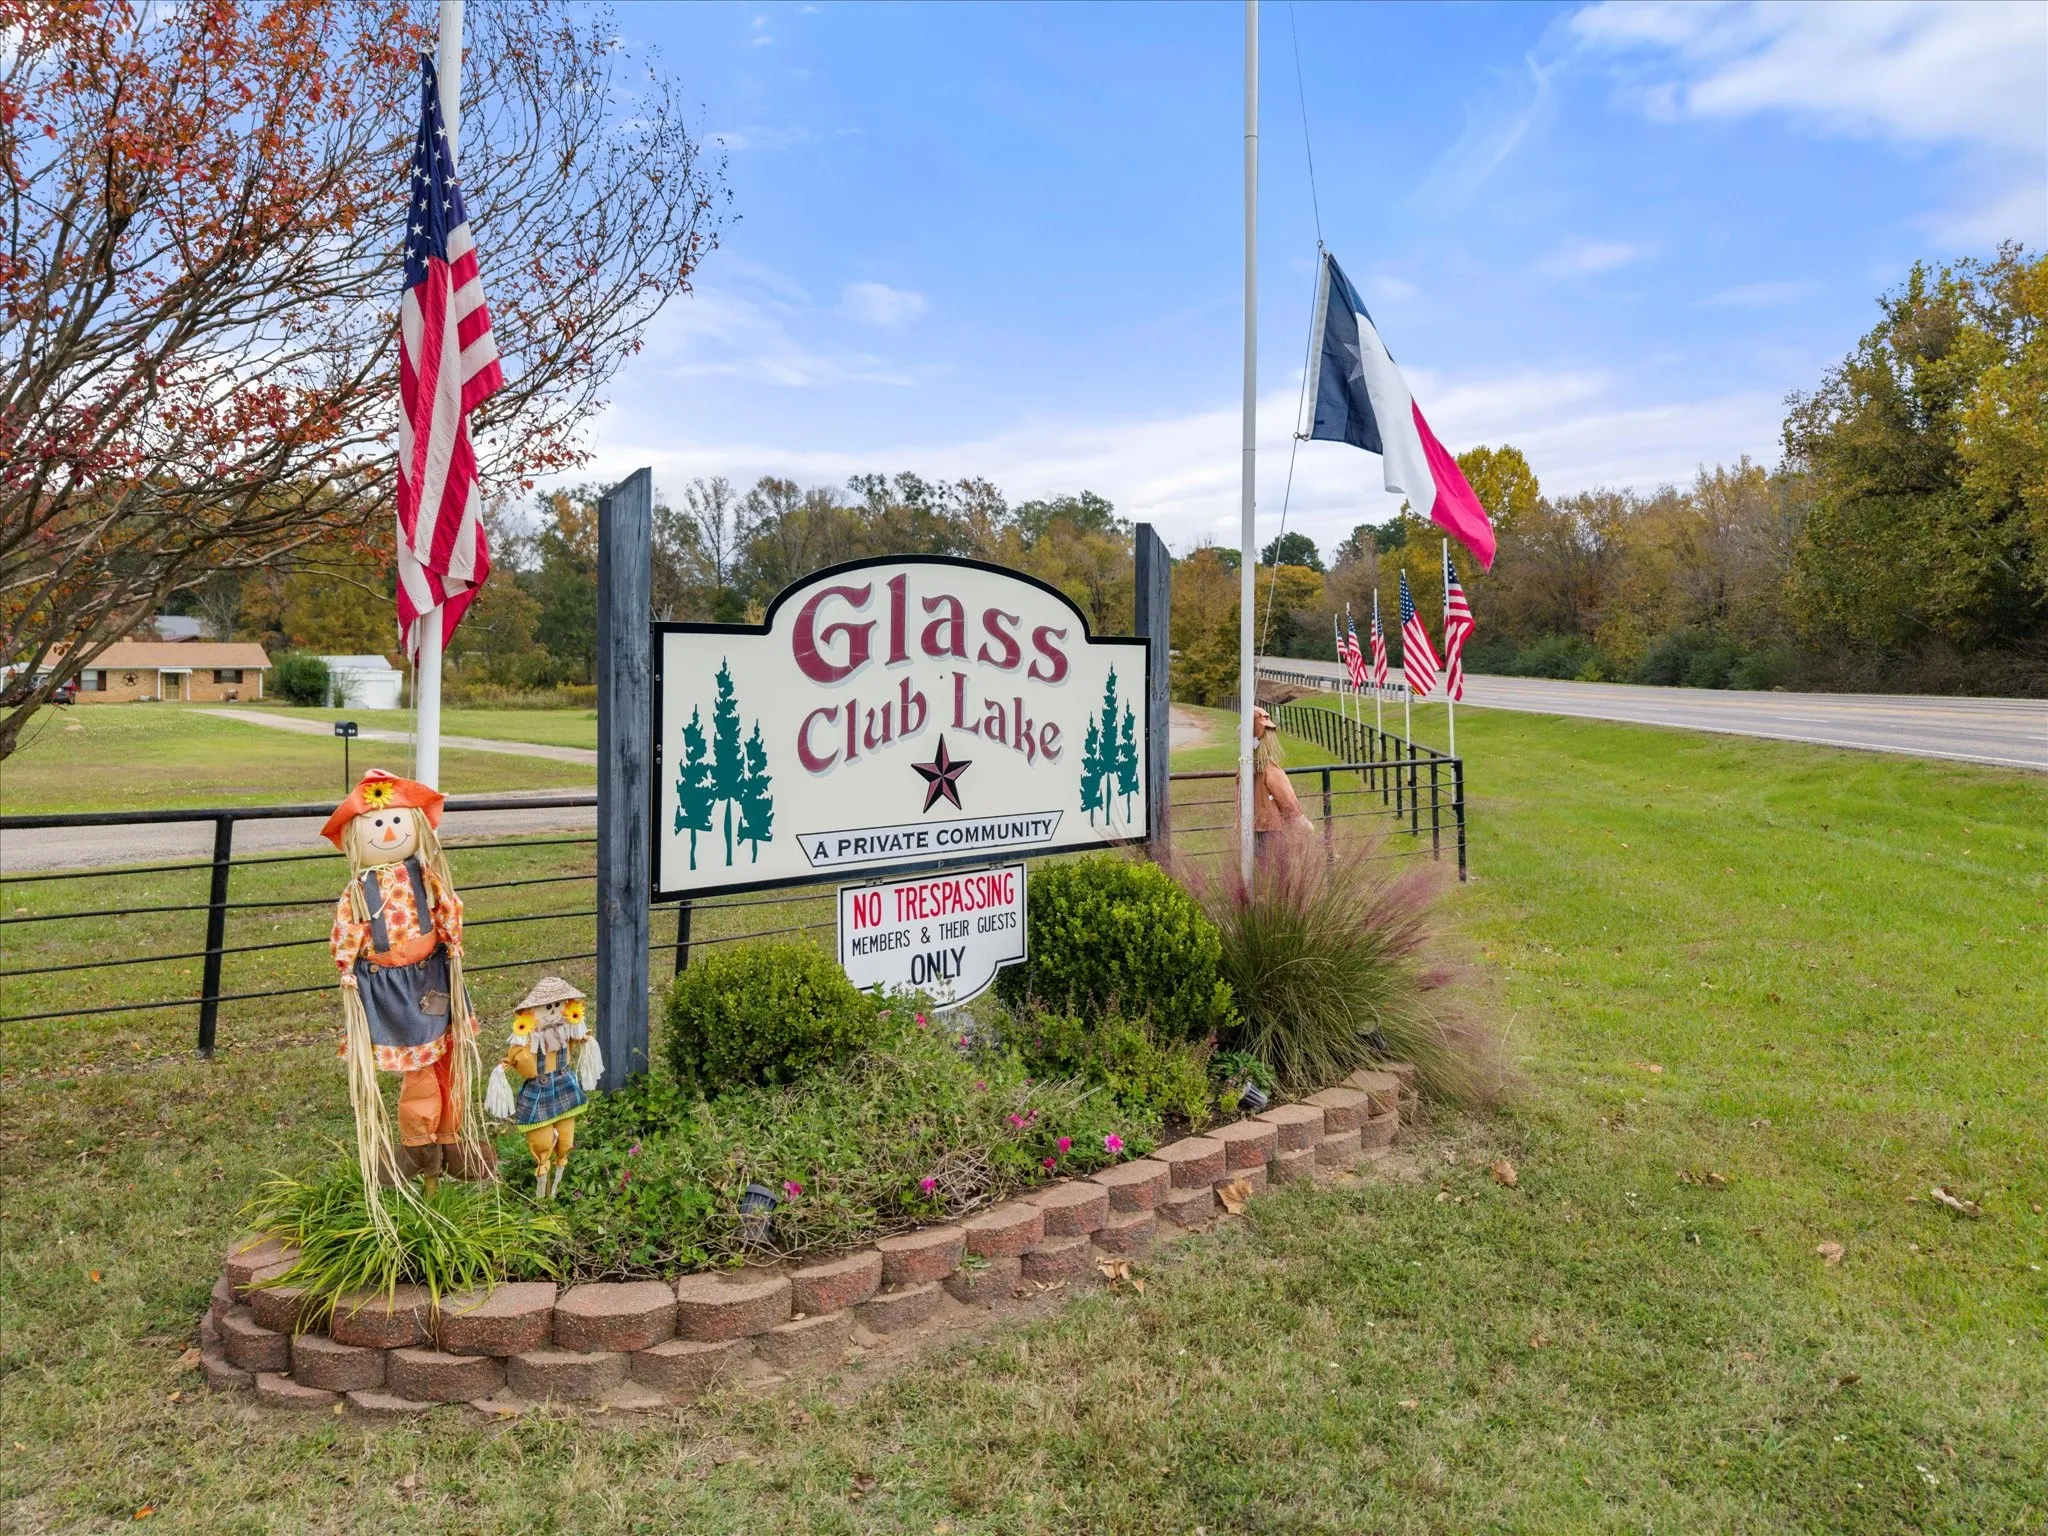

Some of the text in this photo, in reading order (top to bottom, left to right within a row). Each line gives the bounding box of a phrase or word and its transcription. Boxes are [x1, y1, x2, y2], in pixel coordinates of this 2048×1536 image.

[791, 572, 1071, 688] Glass
[797, 671, 1064, 778] Club Lake
[813, 819, 1053, 860] A PRIVATE COMMUNITY
[853, 872, 1014, 930] NO TRESPASSING
[852, 911, 1017, 957] MEMBERS & THEIR GUESTS
[910, 945, 967, 986] ONLY
